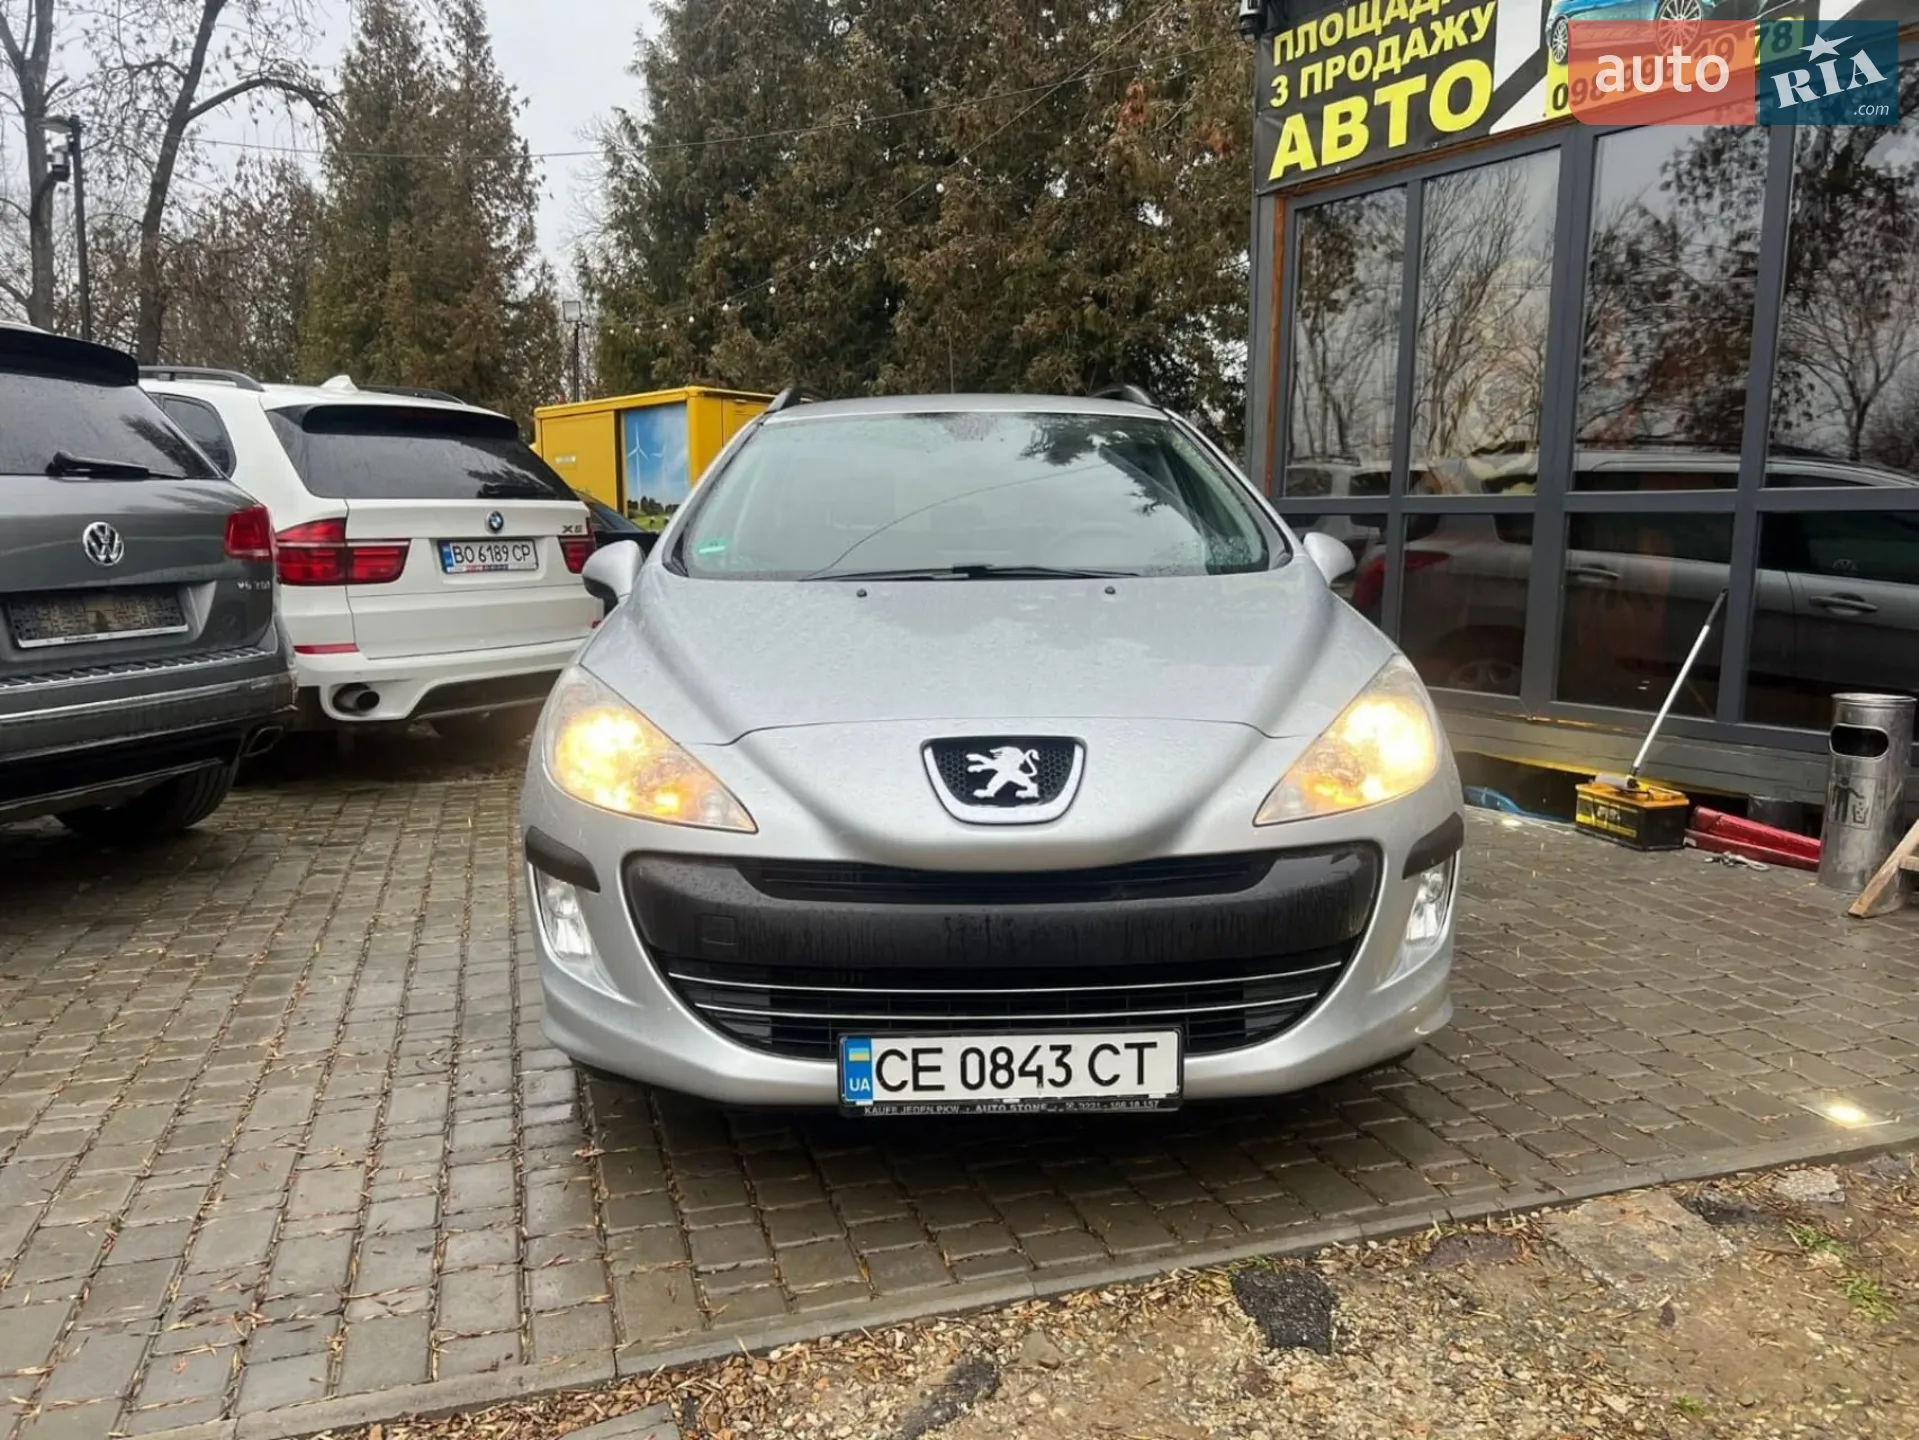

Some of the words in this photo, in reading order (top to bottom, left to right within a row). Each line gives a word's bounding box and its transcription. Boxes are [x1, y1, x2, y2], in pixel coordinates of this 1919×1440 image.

[1273, 0, 1451, 67] ПЛОЩАД
[1300, 1, 1497, 100] ПРОДАЖУ
[1268, 59, 1493, 181] АВТО
[453, 545, 475, 563] BO
[478, 544, 509, 563] 6189
[512, 544, 531, 562] CP
[849, 1077, 871, 1092] UA
[875, 1047, 945, 1093] CE
[960, 1044, 1073, 1091] 0843
[1088, 1042, 1158, 1088] CT
[975, 1103, 1006, 1114] AUTO
